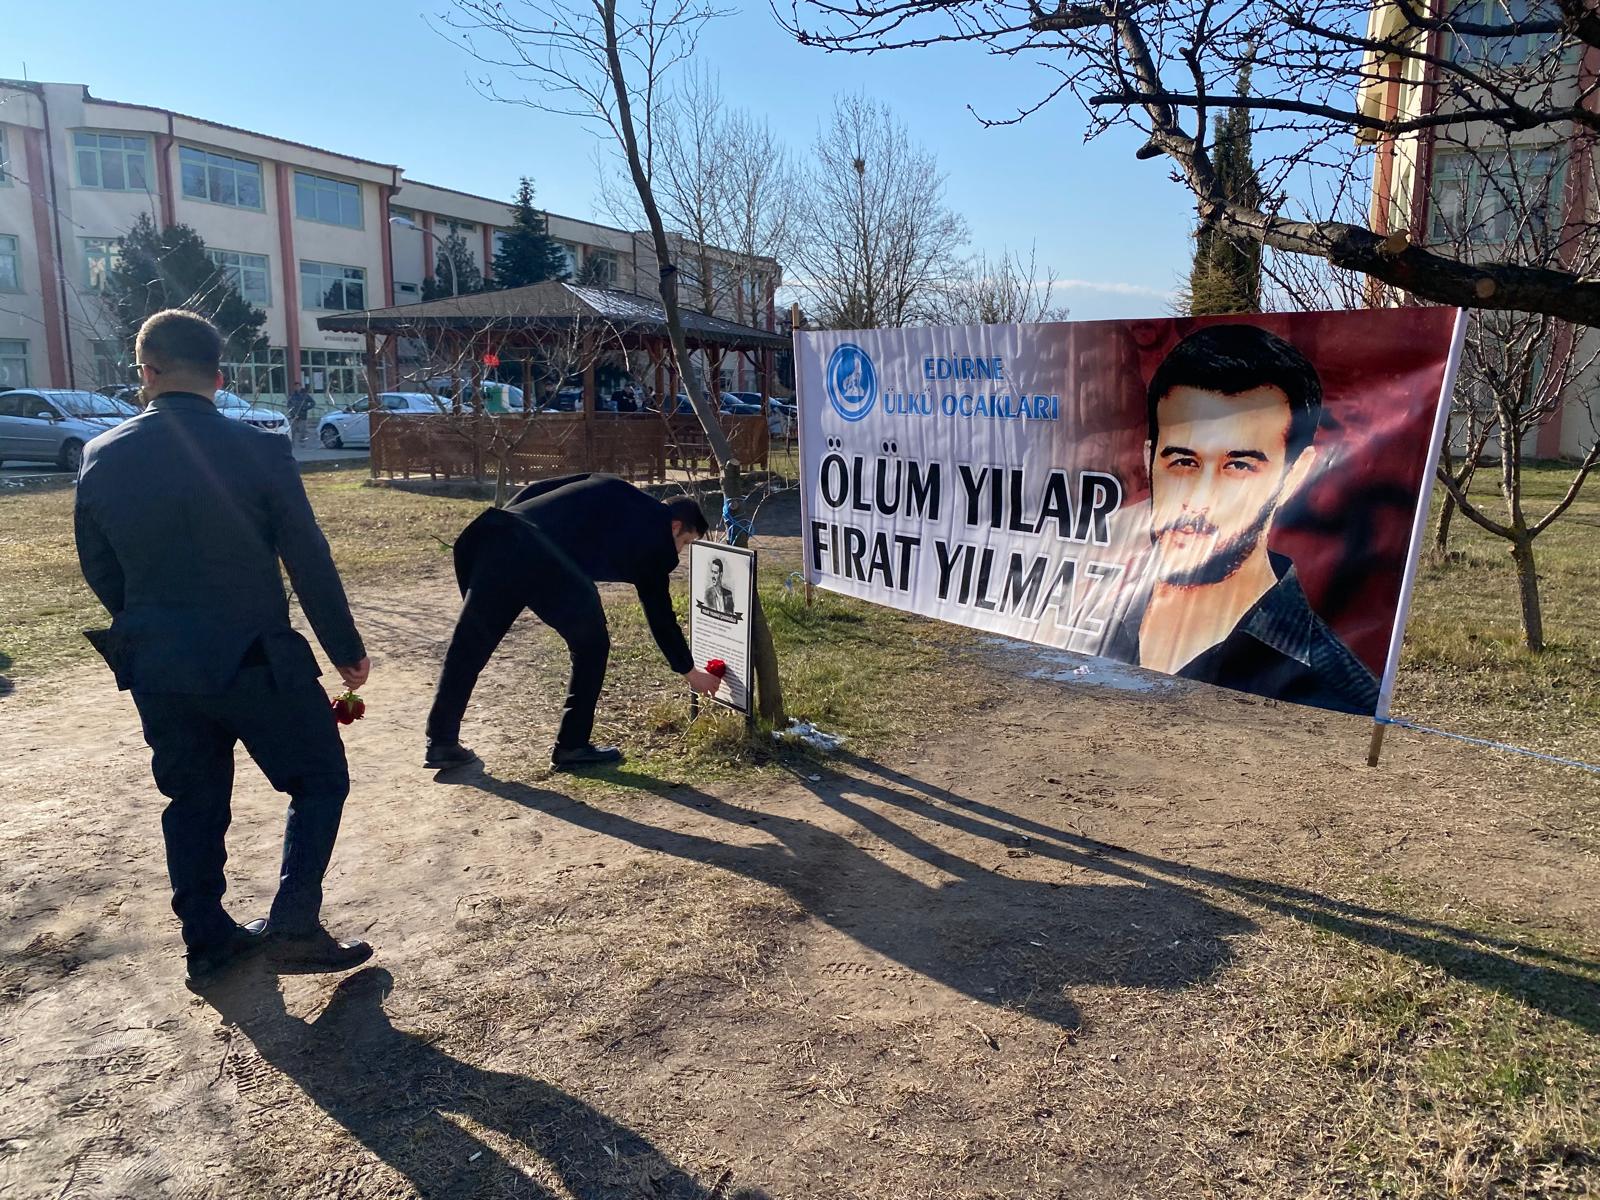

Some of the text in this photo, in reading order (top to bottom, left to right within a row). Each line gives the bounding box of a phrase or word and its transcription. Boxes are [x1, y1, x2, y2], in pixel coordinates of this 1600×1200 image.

[924, 352, 1005, 380] EDİRNE
[883, 386, 1060, 421] ÜLKÜ OCAKLARI
[819, 437, 1121, 545] ÖLÜM YILAR
[811, 520, 1126, 634] FIRAT YILMAZ
